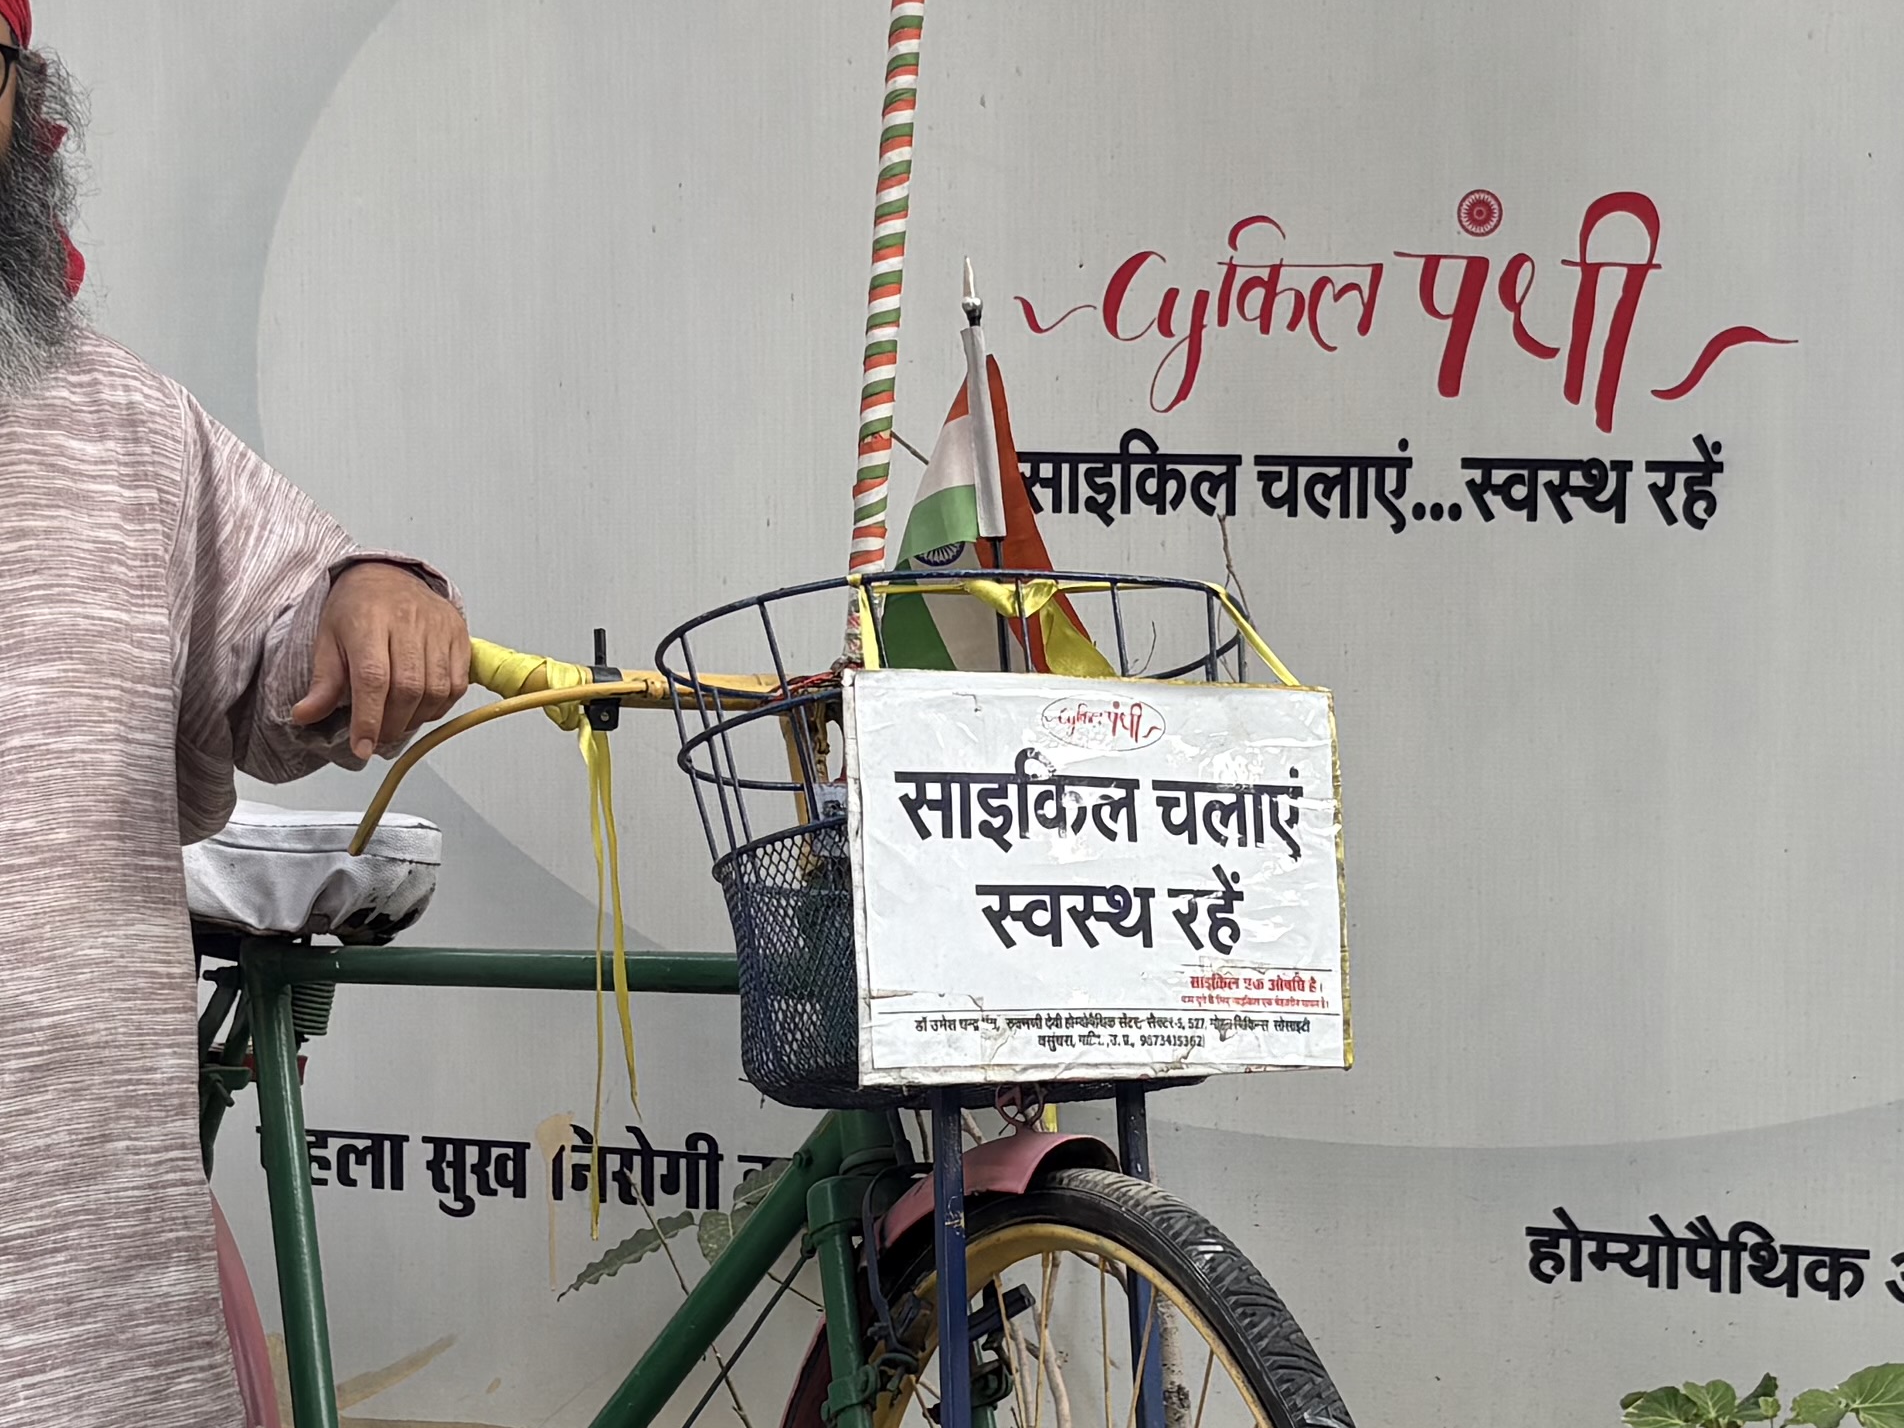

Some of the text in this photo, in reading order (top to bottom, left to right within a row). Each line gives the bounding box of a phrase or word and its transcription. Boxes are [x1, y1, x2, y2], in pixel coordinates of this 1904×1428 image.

[1016, 428, 1241, 528] साइकिल
[1647, 434, 1724, 531] रहें
[895, 747, 1302, 861] साइकिल चलाएं
[976, 864, 1244, 955] स्वस्थ रहें
[256, 1125, 410, 1191] हला
[422, 1135, 531, 1218] सुख
[1525, 1206, 1871, 1301] होम्योपैथिक
